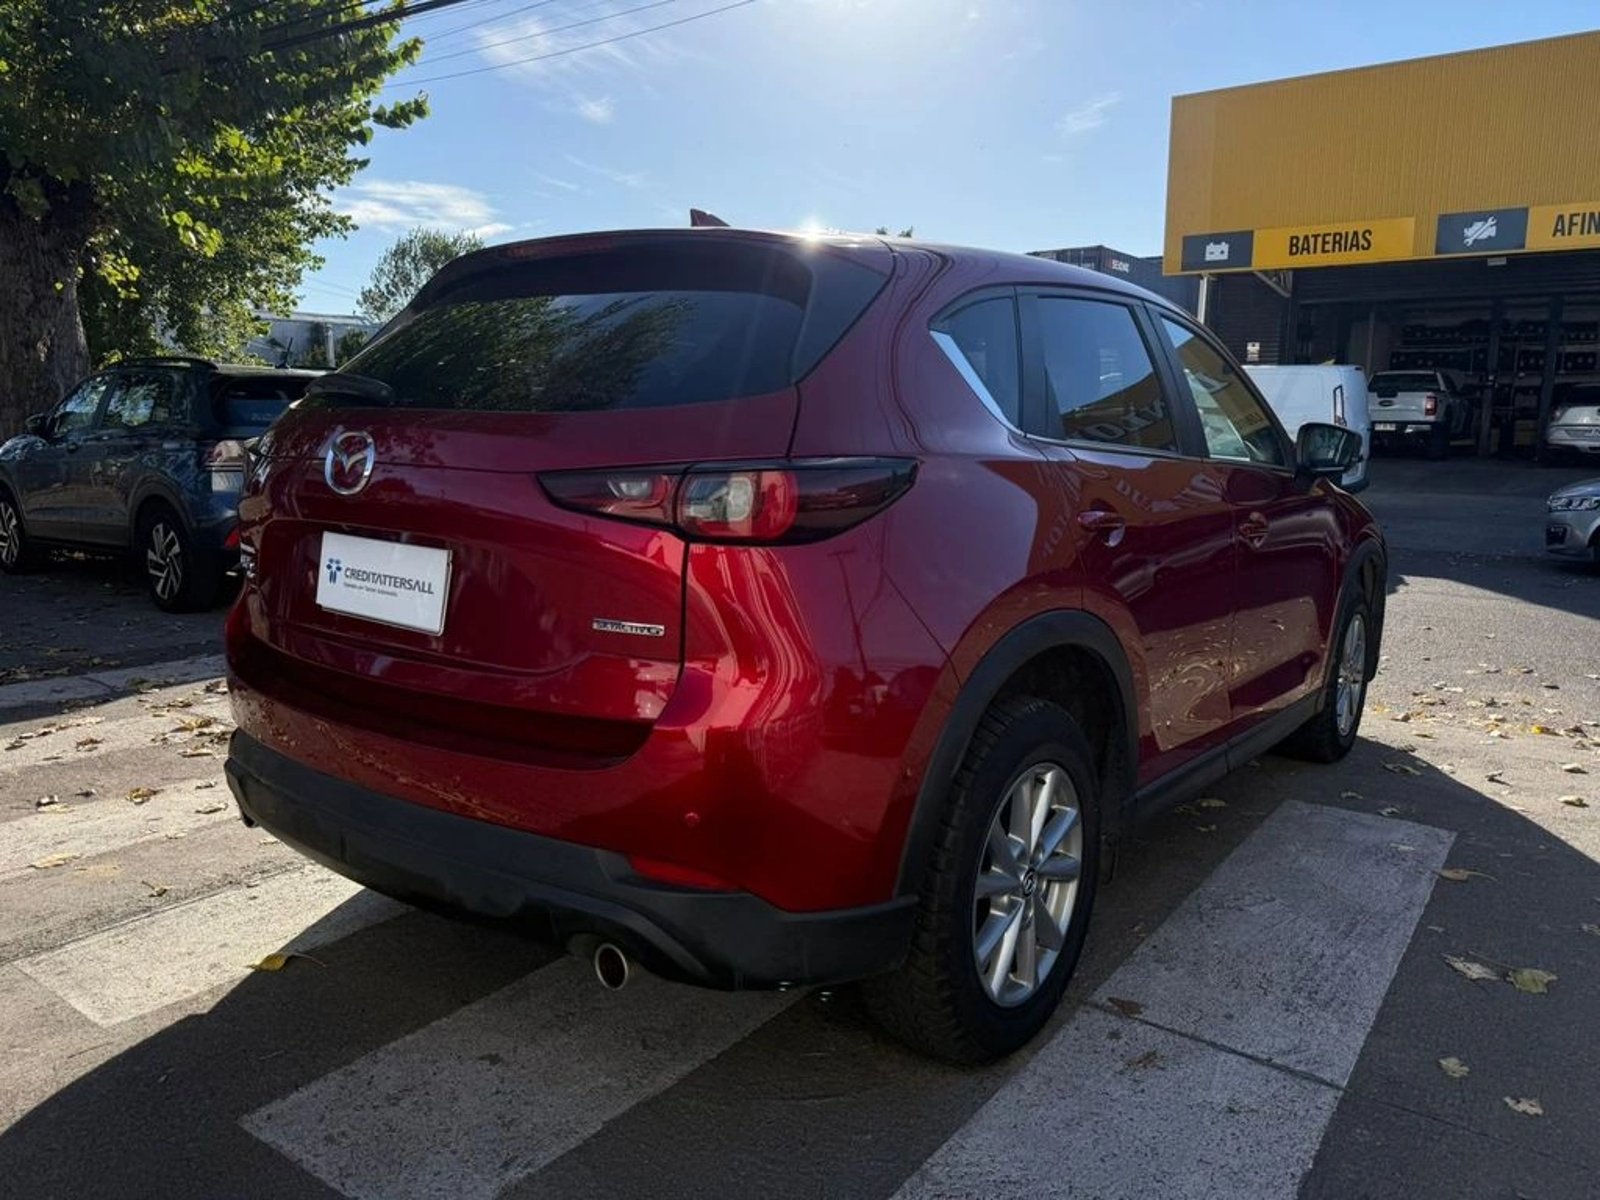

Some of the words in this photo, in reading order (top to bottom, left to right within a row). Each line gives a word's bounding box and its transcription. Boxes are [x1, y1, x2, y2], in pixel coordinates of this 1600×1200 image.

[1552, 211, 1600, 237] AFIN
[1288, 229, 1373, 256] BATERIAS
[344, 567, 434, 594] CREDITATTERSALL
